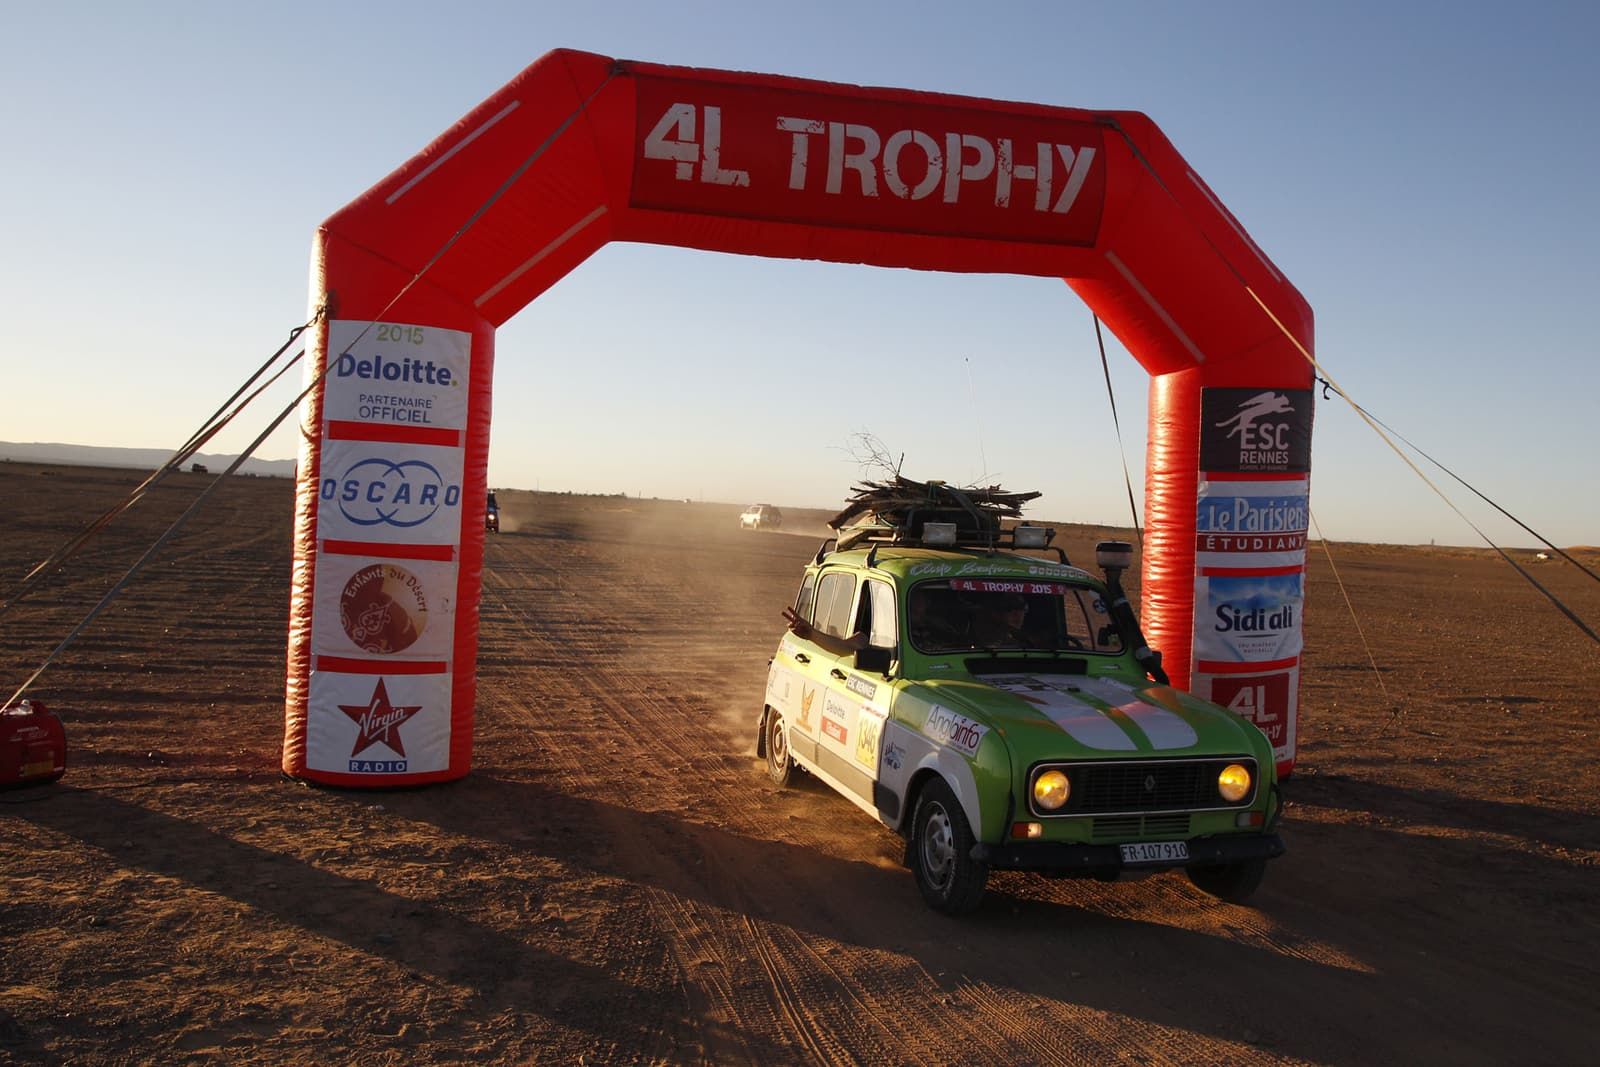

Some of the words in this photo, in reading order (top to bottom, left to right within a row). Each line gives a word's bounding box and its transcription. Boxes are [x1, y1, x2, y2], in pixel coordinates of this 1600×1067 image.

[644, 102, 750, 188] 4L
[775, 116, 1097, 214] TROPHY
[375, 324, 424, 345] 2015
[358, 405, 431, 424] OFFICIEL
[359, 393, 433, 409] PARTENAIRE
[1240, 422, 1291, 451] ESC
[1239, 450, 1289, 464] RENNES
[320, 477, 461, 507] OSCARO
[1208, 504, 1232, 532] Le
[1233, 497, 1304, 532] Parisien
[1206, 534, 1304, 550] ÉTUDIANT
[405, 575, 428, 613] Désert
[962, 581, 977, 591] 4L
[982, 582, 1024, 593] TROPHY
[1031, 583, 1052, 594] 2015
[1215, 603, 1266, 633] Sidi
[1226, 685, 1278, 723] 4L
[358, 698, 406, 742] Virgin
[350, 762, 407, 772] RADIO
